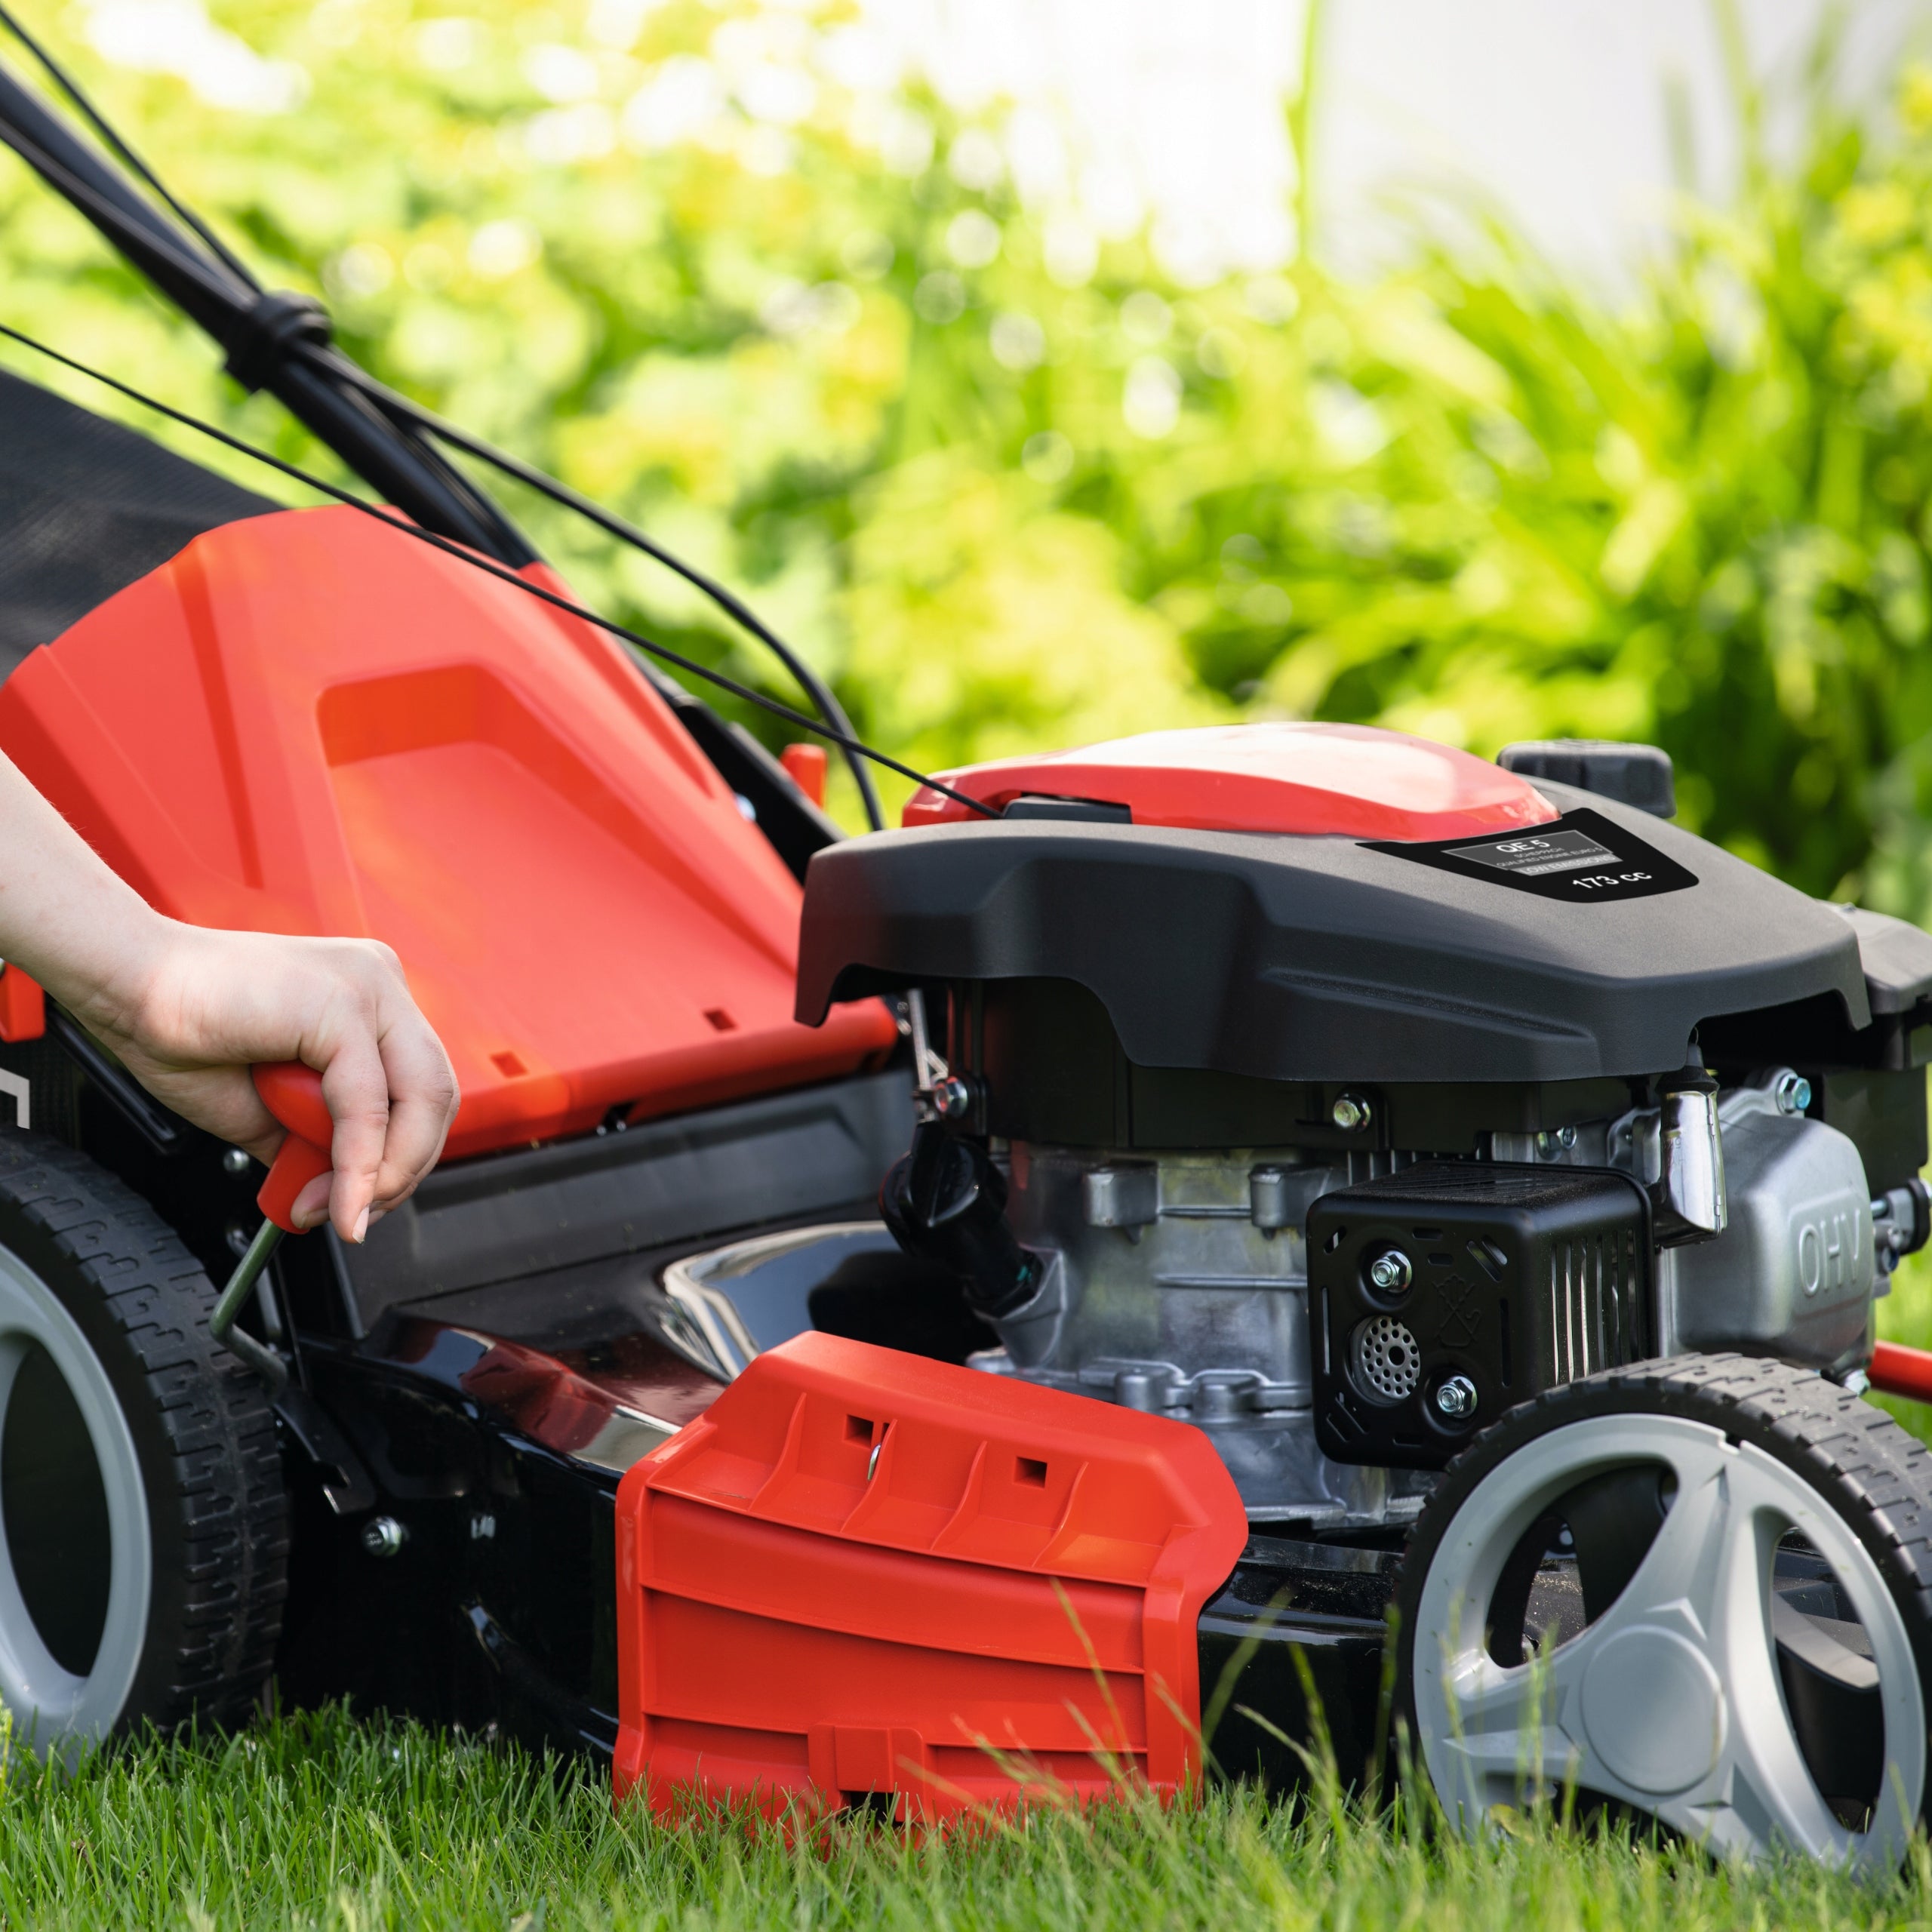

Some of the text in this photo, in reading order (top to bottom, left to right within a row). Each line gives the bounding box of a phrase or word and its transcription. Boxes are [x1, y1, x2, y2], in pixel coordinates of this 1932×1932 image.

[1496, 839, 1550, 853] QE 5
[1572, 872, 1653, 889] 173 cc
[1798, 1208, 1861, 1298] OHV
